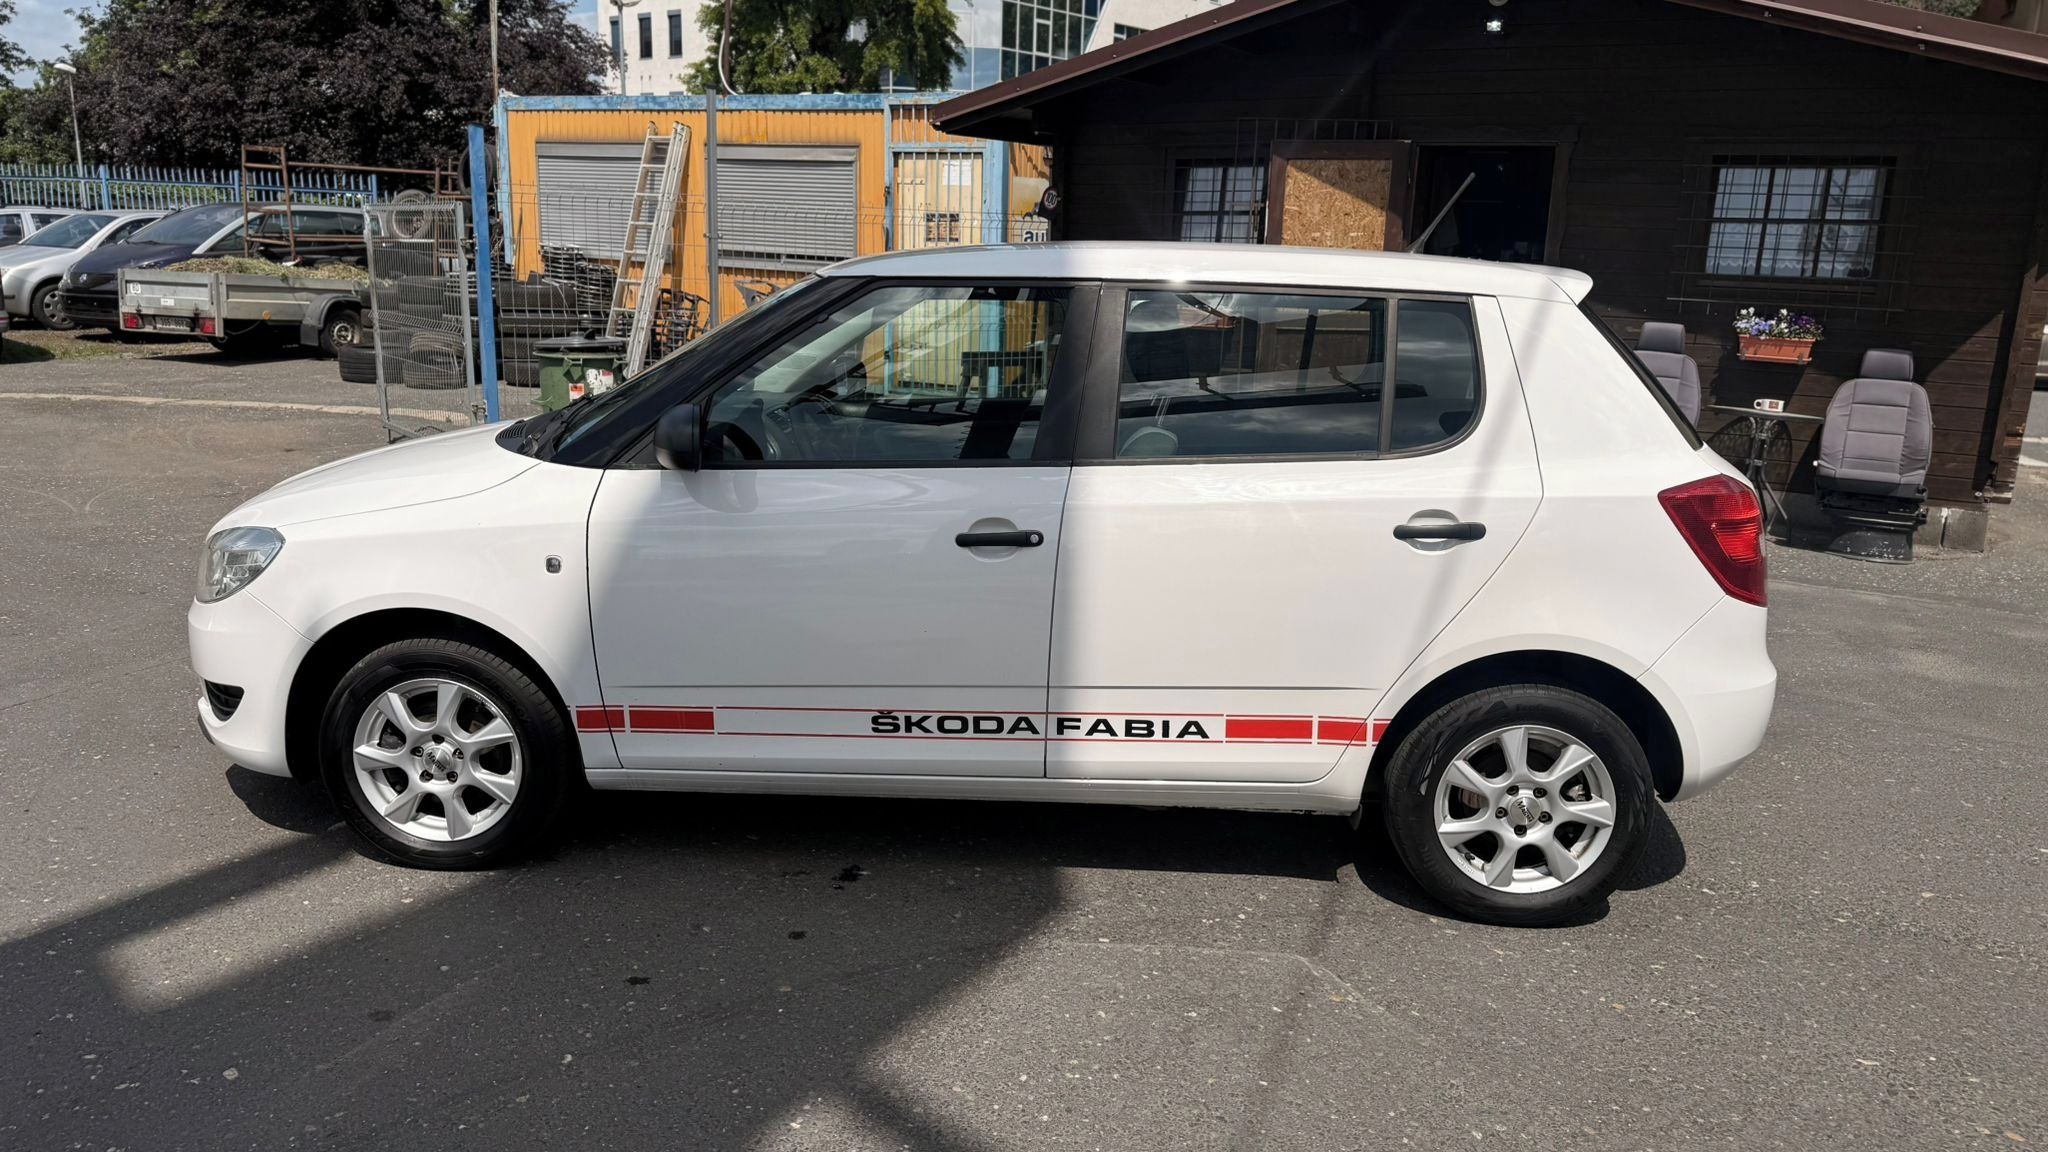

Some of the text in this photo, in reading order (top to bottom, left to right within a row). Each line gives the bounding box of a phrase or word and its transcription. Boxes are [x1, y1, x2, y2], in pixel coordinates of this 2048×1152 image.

[1023, 231, 1047, 243] au
[871, 710, 1210, 739] ŠKODA FABIA
